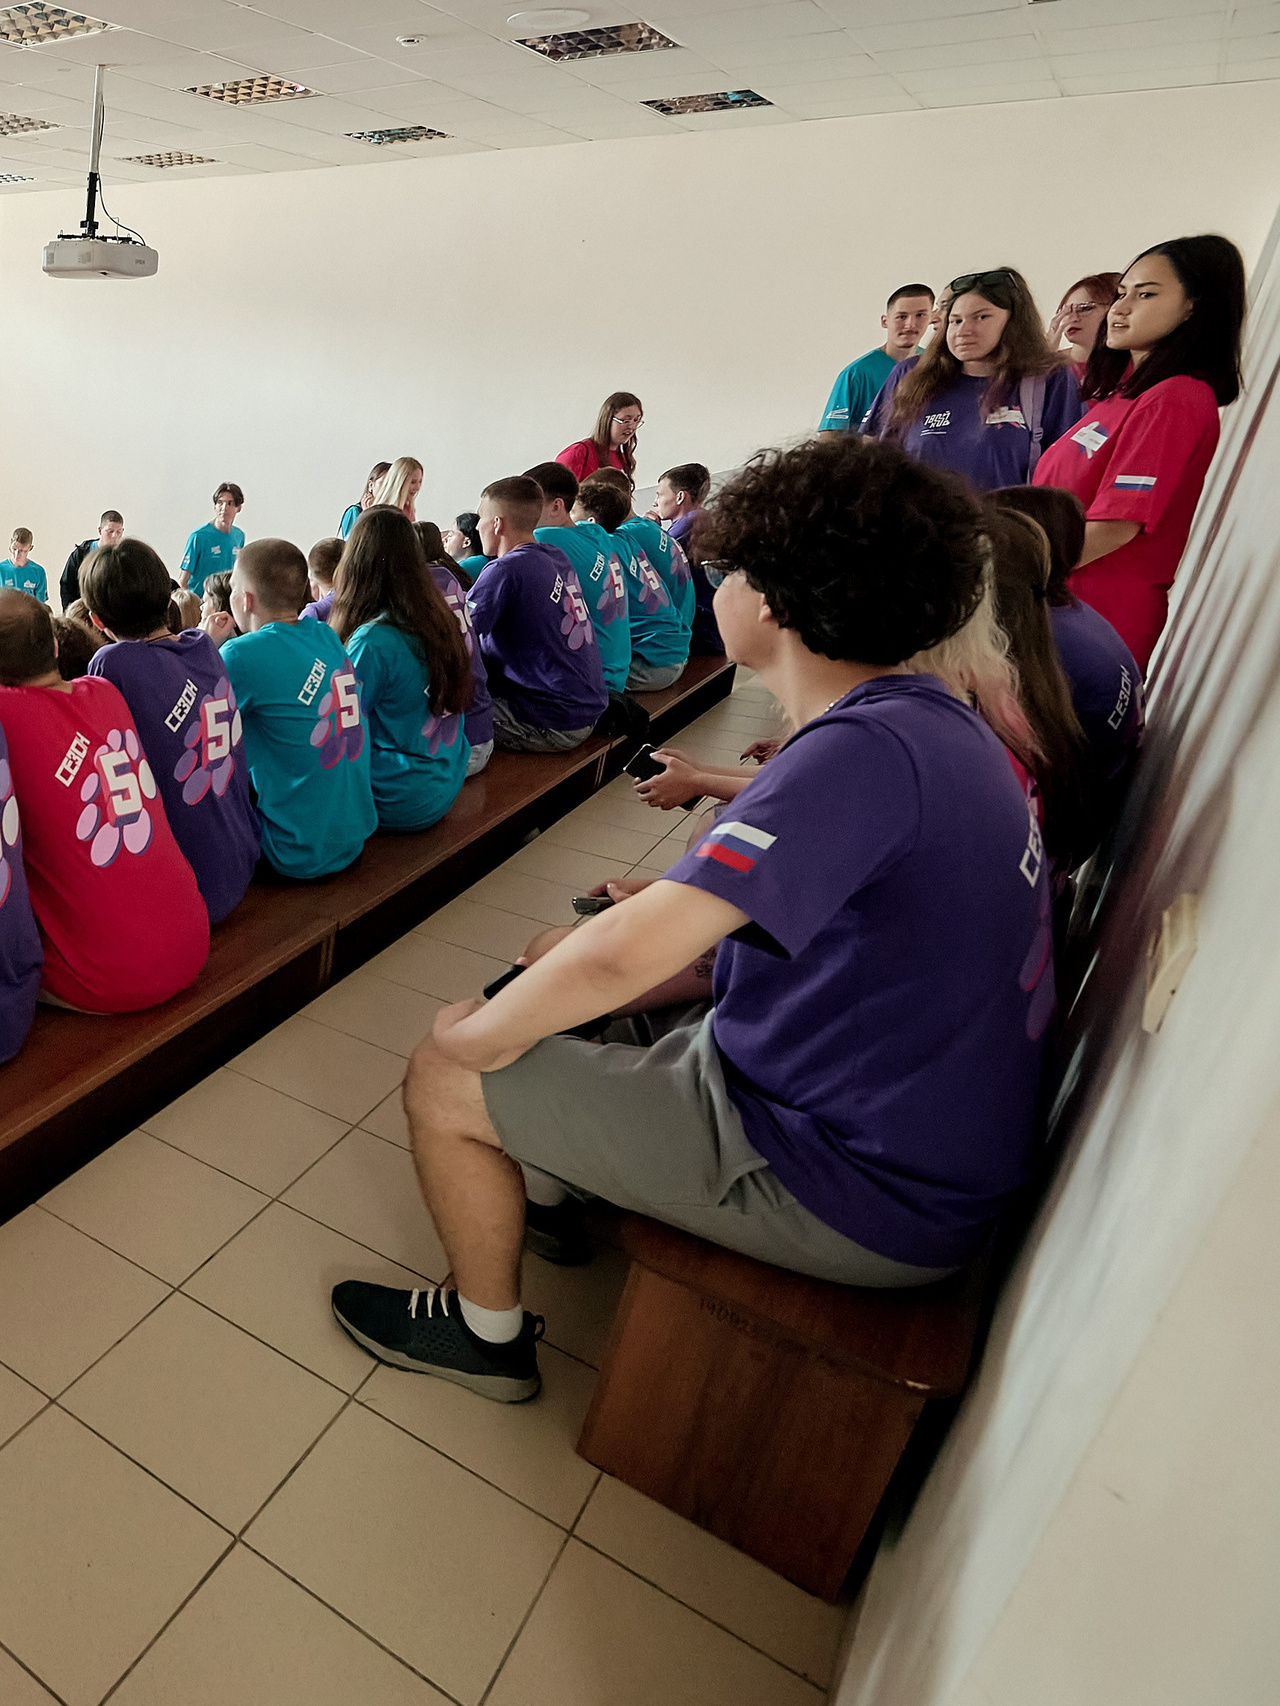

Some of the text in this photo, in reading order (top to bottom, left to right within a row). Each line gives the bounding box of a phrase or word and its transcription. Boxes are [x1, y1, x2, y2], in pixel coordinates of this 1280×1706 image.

[566, 584, 587, 621] 5
[609, 562, 624, 599] 5
[639, 560, 660, 591] 5
[164, 679, 199, 733] СЕЗОН
[298, 658, 328, 707] СЕЗОН
[333, 673, 360, 729] 5
[1107, 664, 1132, 731] СЕЗОН
[203, 697, 231, 762] 5
[55, 731, 91, 788] СЕЗОН
[98, 750, 143, 816] 5
